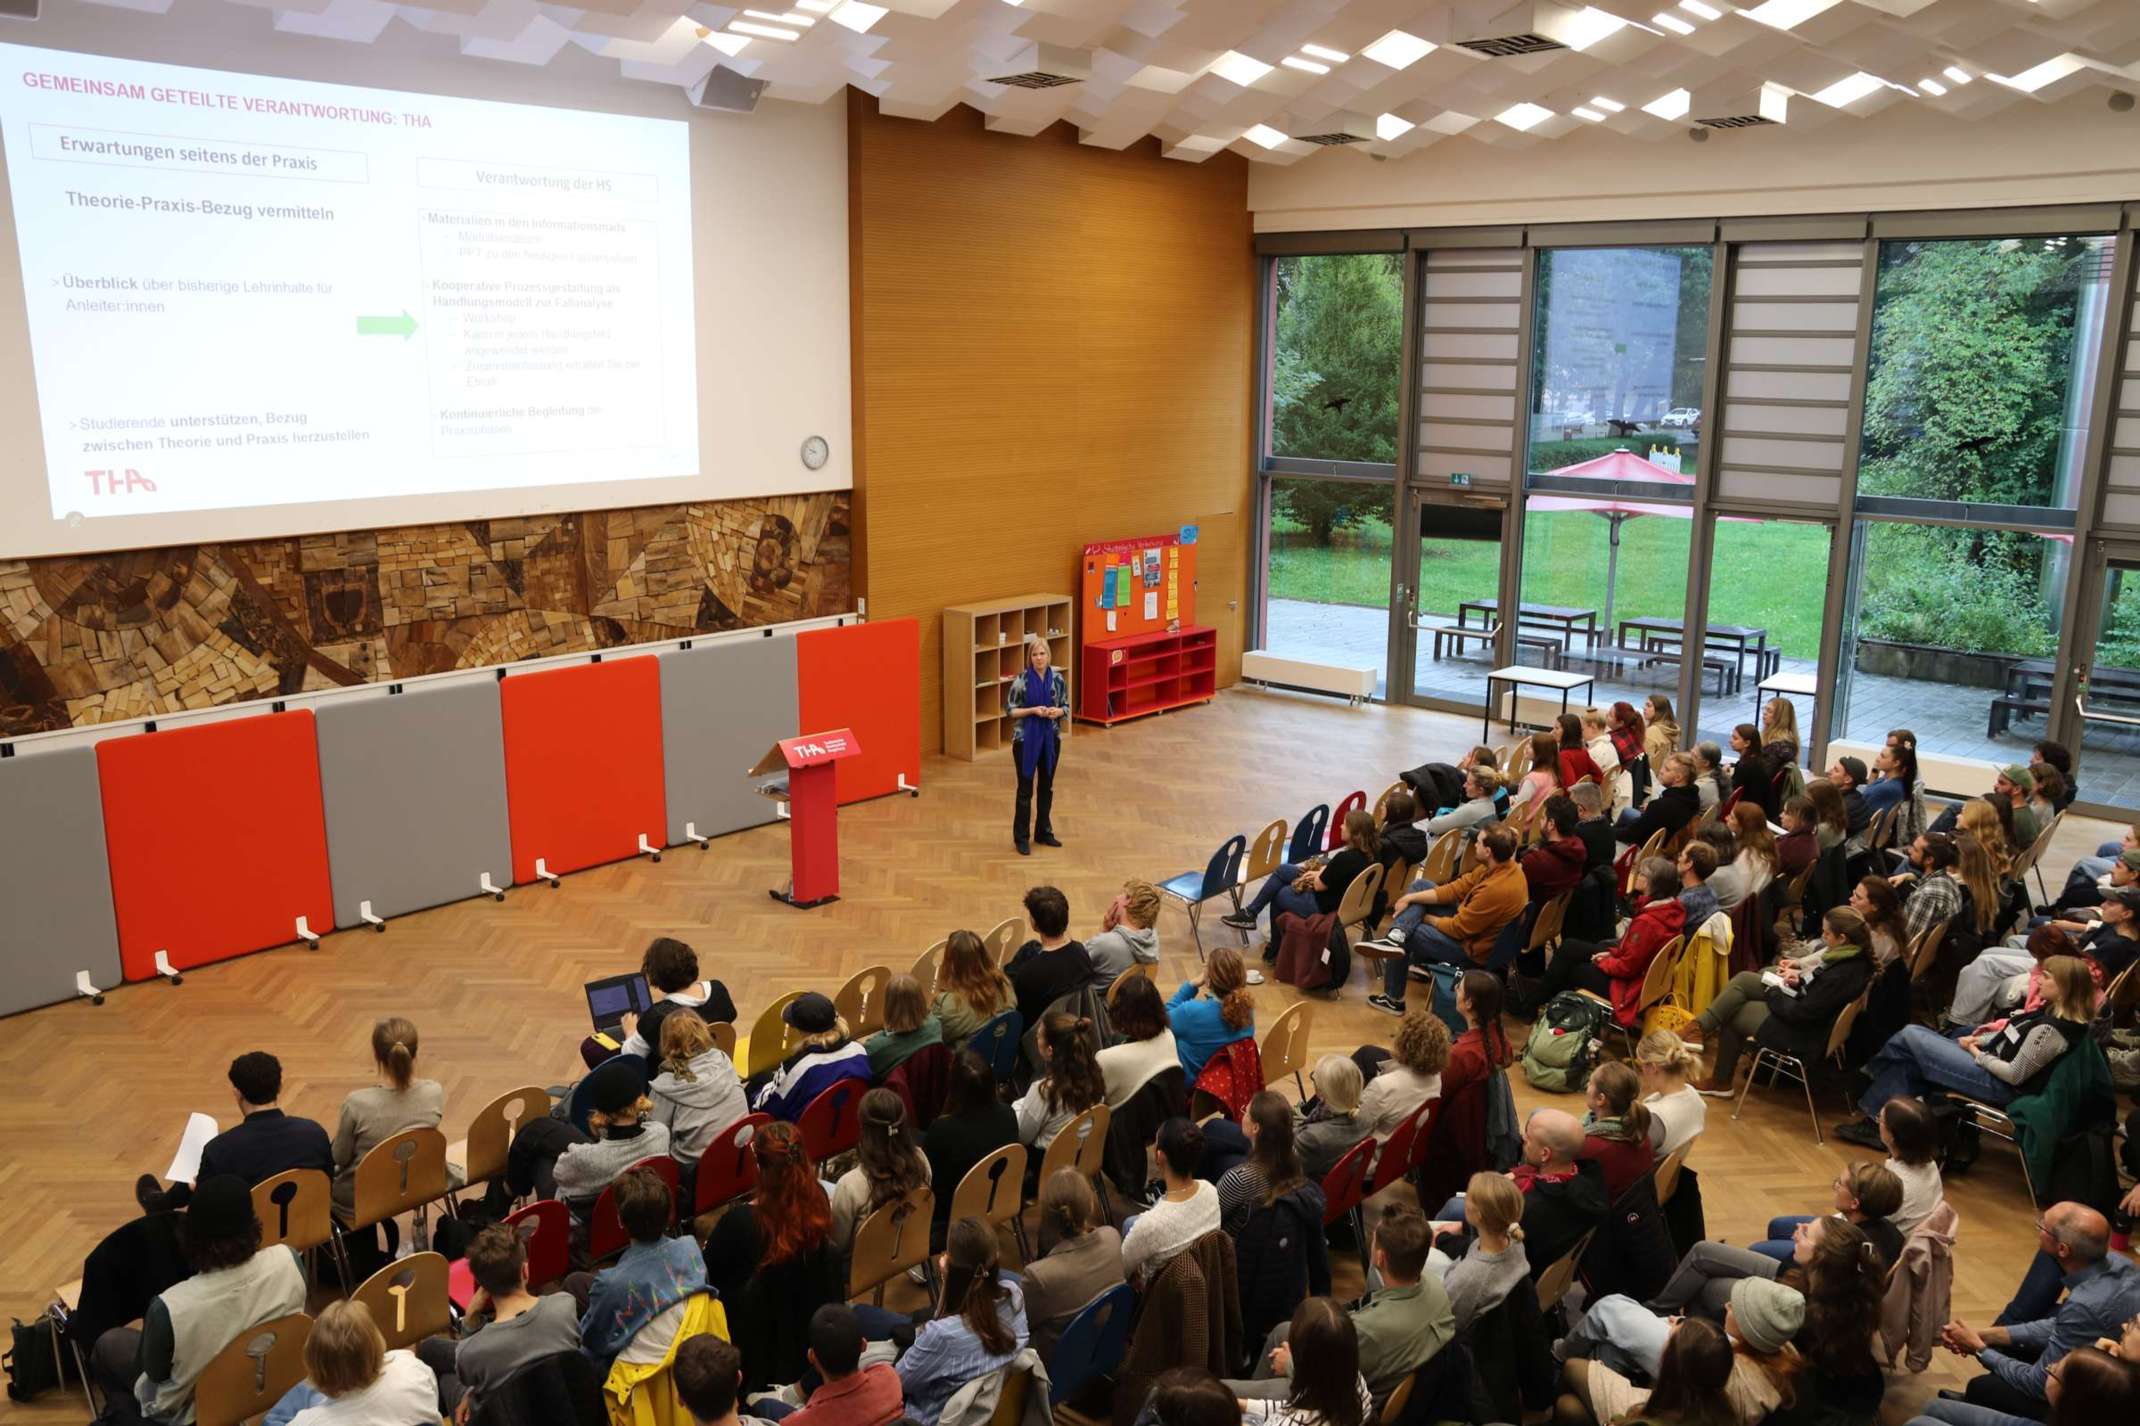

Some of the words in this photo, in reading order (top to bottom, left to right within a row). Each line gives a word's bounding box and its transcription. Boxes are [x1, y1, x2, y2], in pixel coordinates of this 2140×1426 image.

[22, 71, 146, 100] GEMEINSAM
[150, 87, 239, 110] GETEILTE
[243, 97, 398, 125] VERANTWORTUNG:
[402, 112, 433, 129] THA
[60, 135, 175, 162] Erwartungen
[179, 147, 238, 166] seitens
[242, 151, 268, 167] der
[272, 154, 318, 171] Praxis
[475, 170, 571, 193] Verantwortung
[573, 176, 594, 191] der
[595, 179, 613, 193] HS
[65, 190, 253, 220] Theorie-Praxis-Bezug
[257, 203, 335, 222] vermitteln
[62, 273, 139, 292] Überblick
[142, 277, 174, 292] über
[177, 278, 240, 295] bisherige
[243, 279, 314, 295] Lehrinhalte
[316, 281, 333, 295] für
[65, 297, 166, 314] Anleiter:innen
[79, 415, 166, 432] Studierende
[169, 412, 263, 430] unterstützen,
[265, 410, 309, 427] Bezug
[82, 436, 154, 453] zwischen
[157, 435, 213, 450] Theorie
[215, 432, 243, 448] und
[246, 431, 289, 446] Praxis
[292, 427, 371, 444] herzustellen
